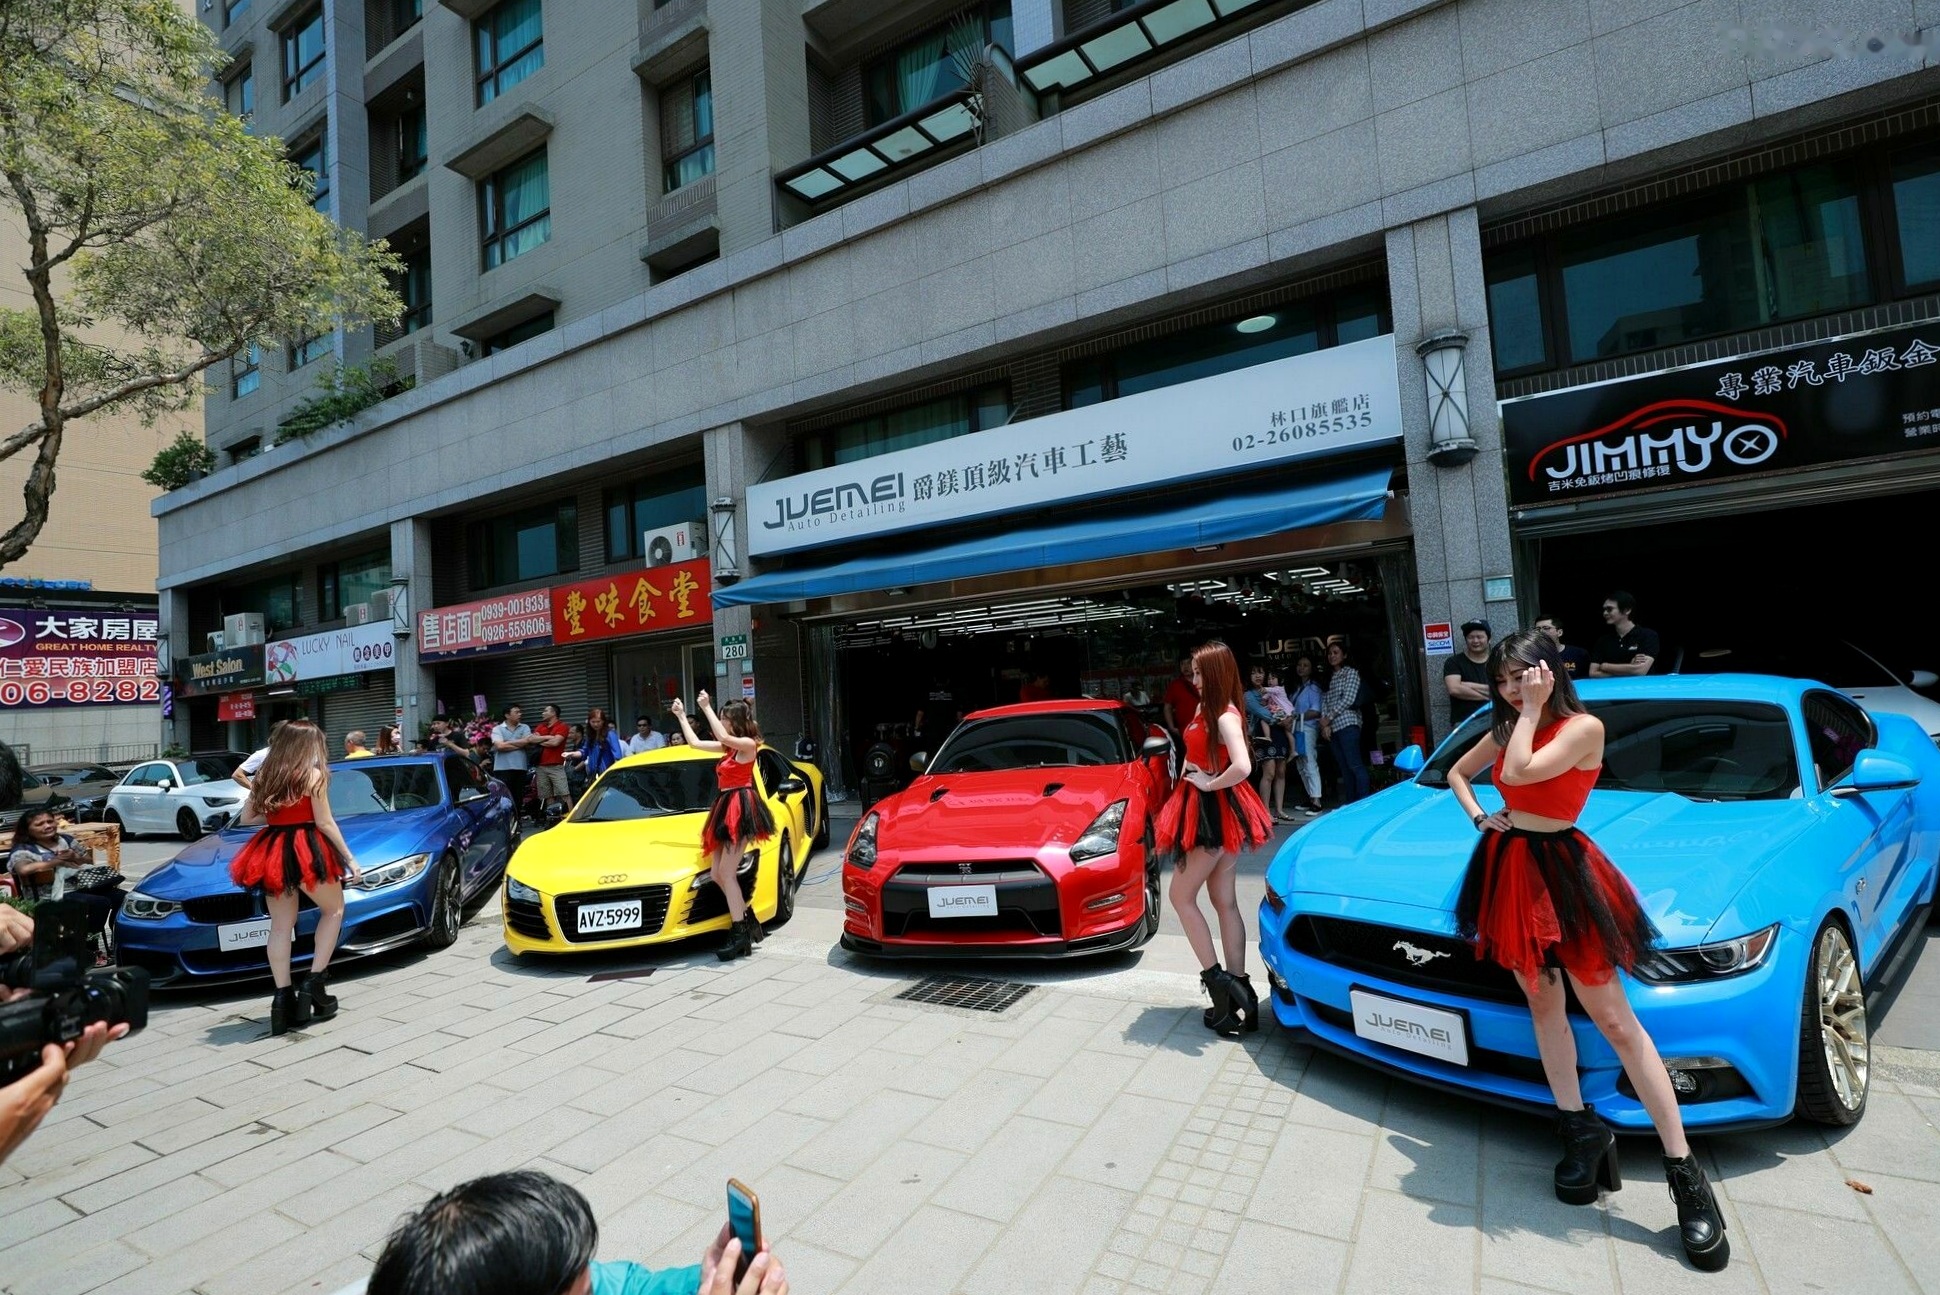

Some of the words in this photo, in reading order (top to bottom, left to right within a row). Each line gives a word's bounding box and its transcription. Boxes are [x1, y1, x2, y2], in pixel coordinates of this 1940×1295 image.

[1716, 339, 1940, 400] 專業汽車鈑金
[1271, 394, 1370, 428] 林口旗艦店
[1232, 411, 1372, 452] 02-26085535
[913, 432, 1128, 502] 爵鎂頂級汽車工藝
[763, 472, 905, 530] JUEMEI
[788, 517, 821, 532] Auto
[829, 501, 906, 524] Detailing
[481, 594, 544, 621] 0939-001933
[563, 570, 699, 636] 豐味食堂
[35, 616, 158, 641] 大家房屋
[422, 611, 471, 649] 售店面
[482, 616, 545, 643] 0926-553606
[35, 643, 76, 651] GREAT
[80, 643, 113, 651] HOME
[116, 644, 158, 652] REALTY
[302, 638, 330, 655] LUCKY
[336, 631, 355, 649] NAIL
[725, 645, 744, 658] 280
[0, 657, 159, 678] 仁愛民族加盟店
[192, 660, 215, 679] West
[216, 657, 243, 674] Salon
[0, 679, 160, 704] 06-8282
[937, 896, 989, 908] JUEMEI
[1365, 1012, 1451, 1044] JUEMEI
